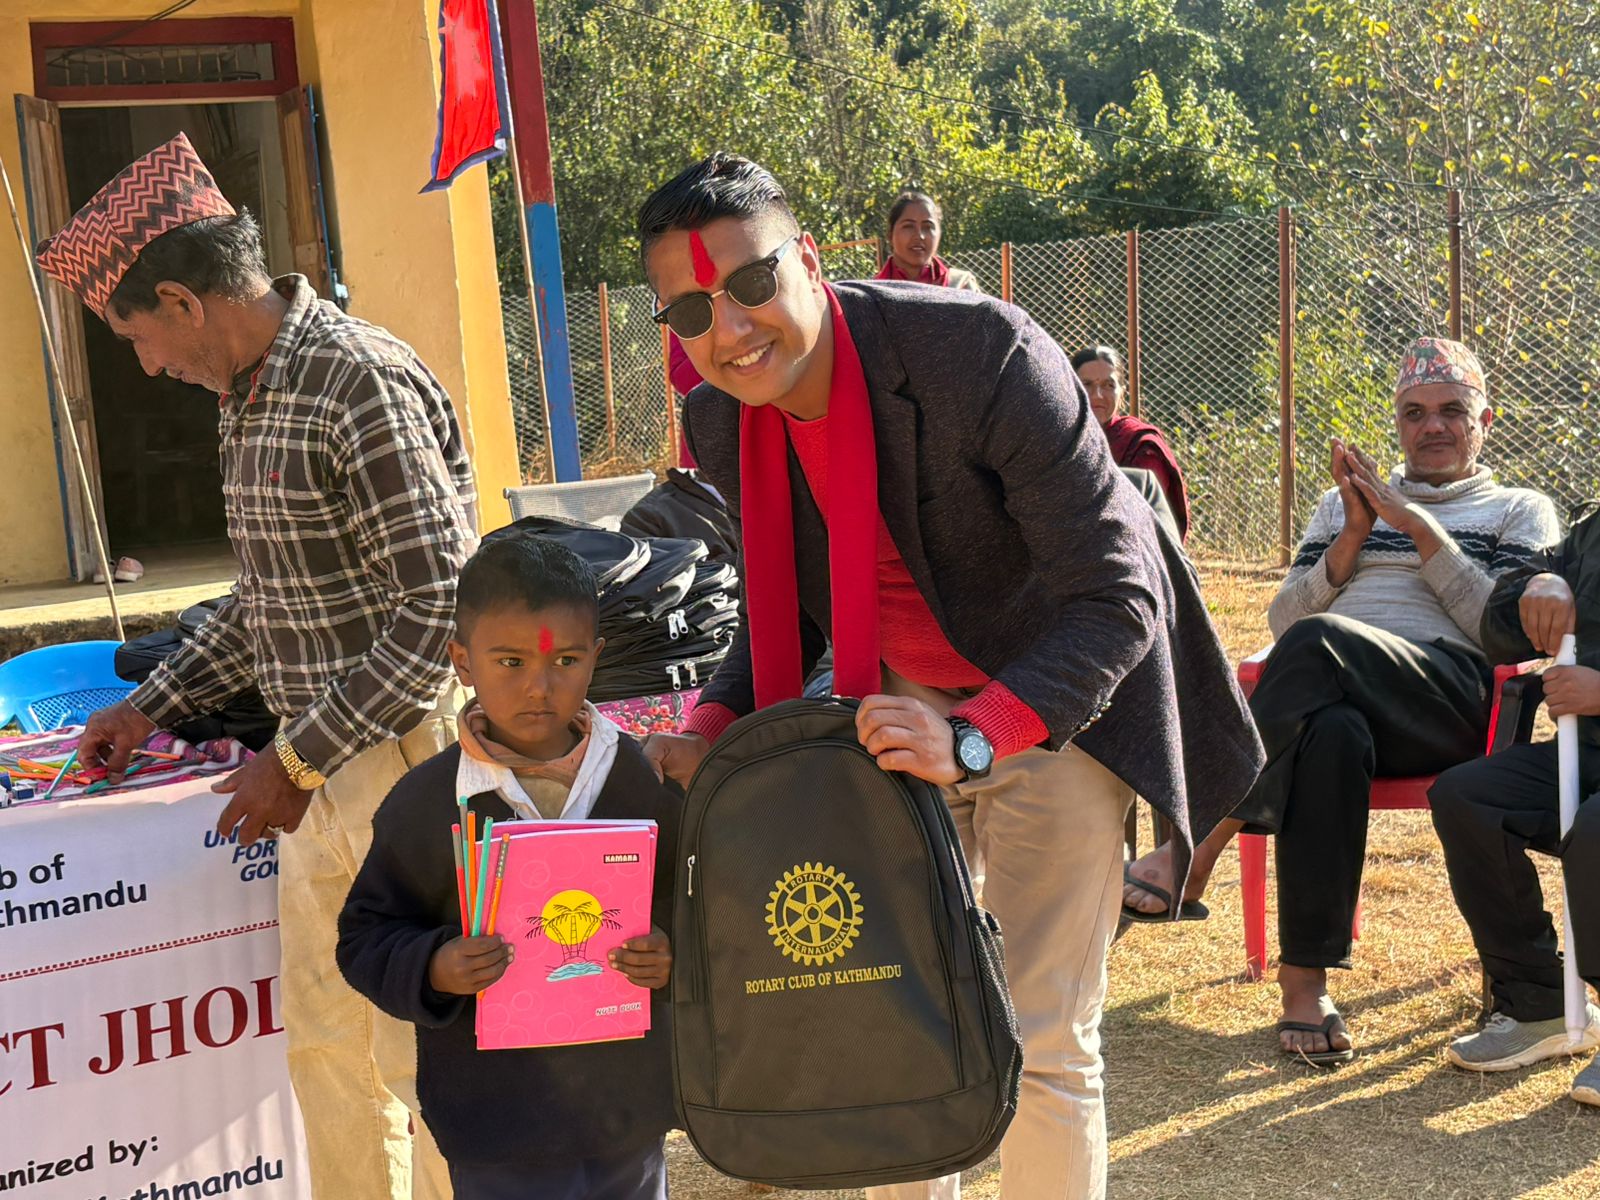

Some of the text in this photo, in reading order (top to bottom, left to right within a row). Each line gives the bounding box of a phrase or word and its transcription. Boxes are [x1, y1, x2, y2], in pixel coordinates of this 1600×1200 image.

[232, 839, 276, 864] FOR
[29, 853, 66, 884] of
[790, 874, 828, 887] ROTARY
[781, 924, 850, 956] INTERNATIONAL
[745, 964, 902, 994] ROTARY CLUB OF KATHMANDU
[109, 1136, 160, 1167] by:
